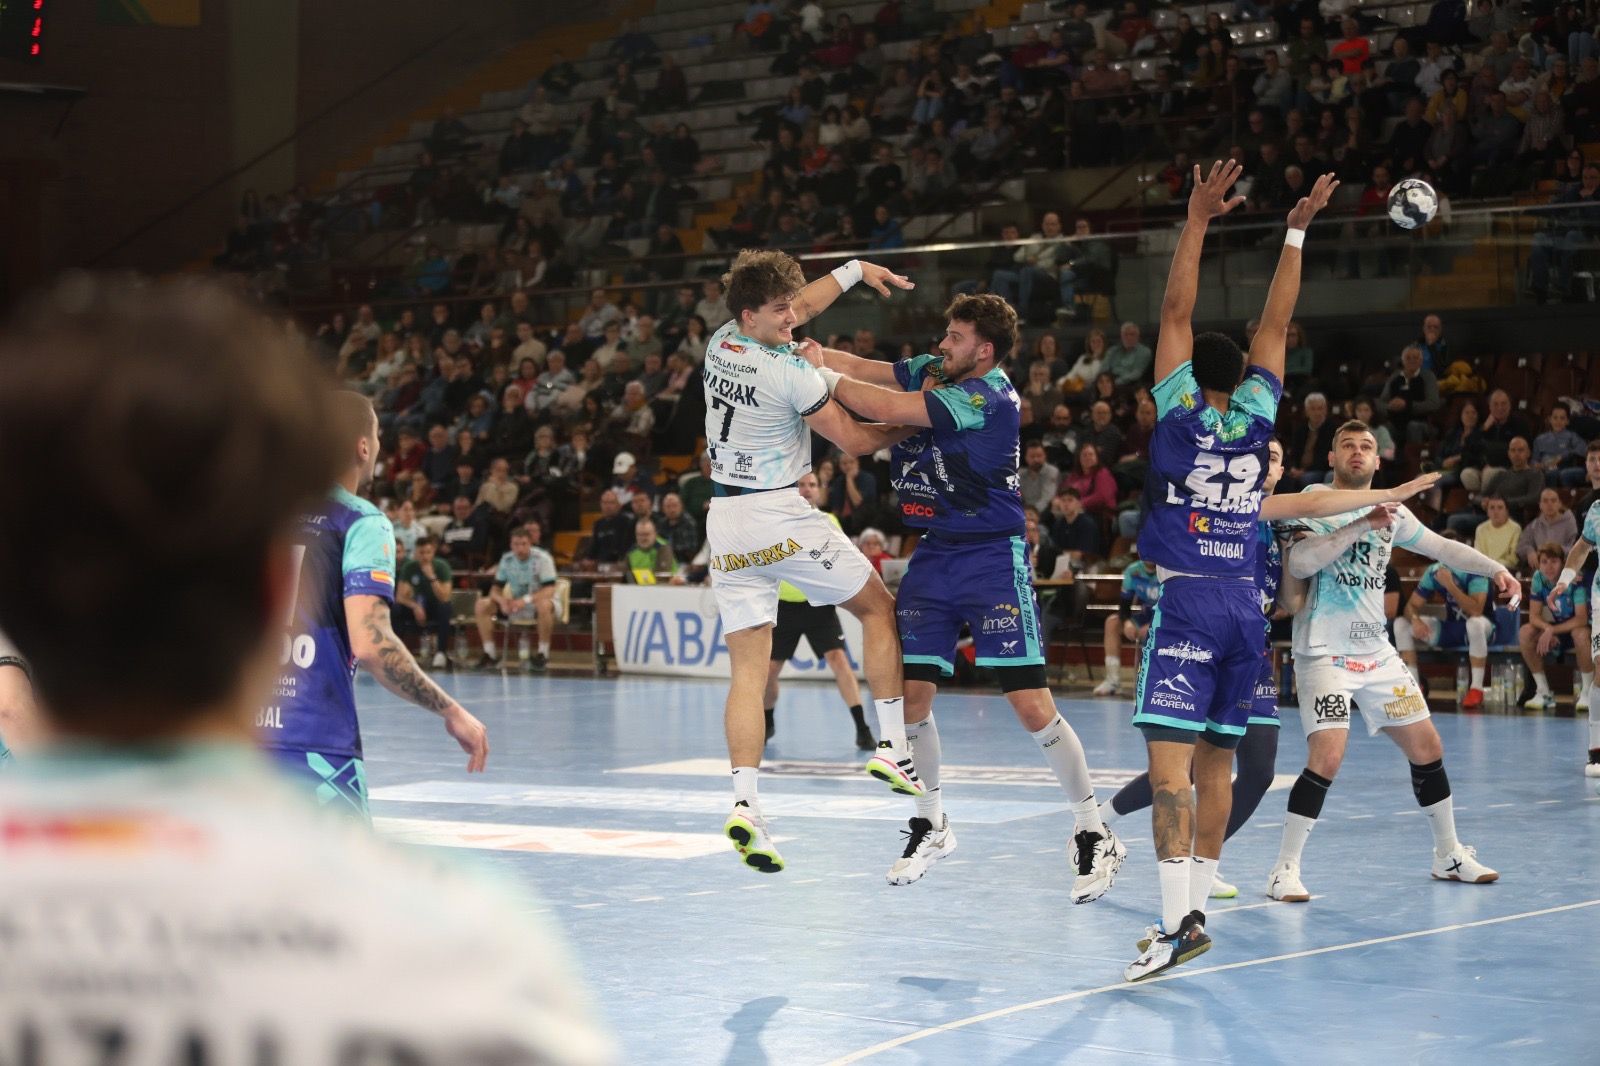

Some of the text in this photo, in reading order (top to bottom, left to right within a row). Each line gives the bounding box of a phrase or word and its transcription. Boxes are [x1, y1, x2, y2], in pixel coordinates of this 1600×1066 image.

[738, 364, 758, 375] LEÓN
[711, 396, 735, 442] 7
[1185, 452, 1262, 500] 29
[982, 615, 1018, 630] imex
[1152, 691, 1182, 701] SIERRA
[1150, 697, 1196, 712] MORENA
[1315, 704, 1349, 718] VEGA
[254, 707, 284, 729] BAL
